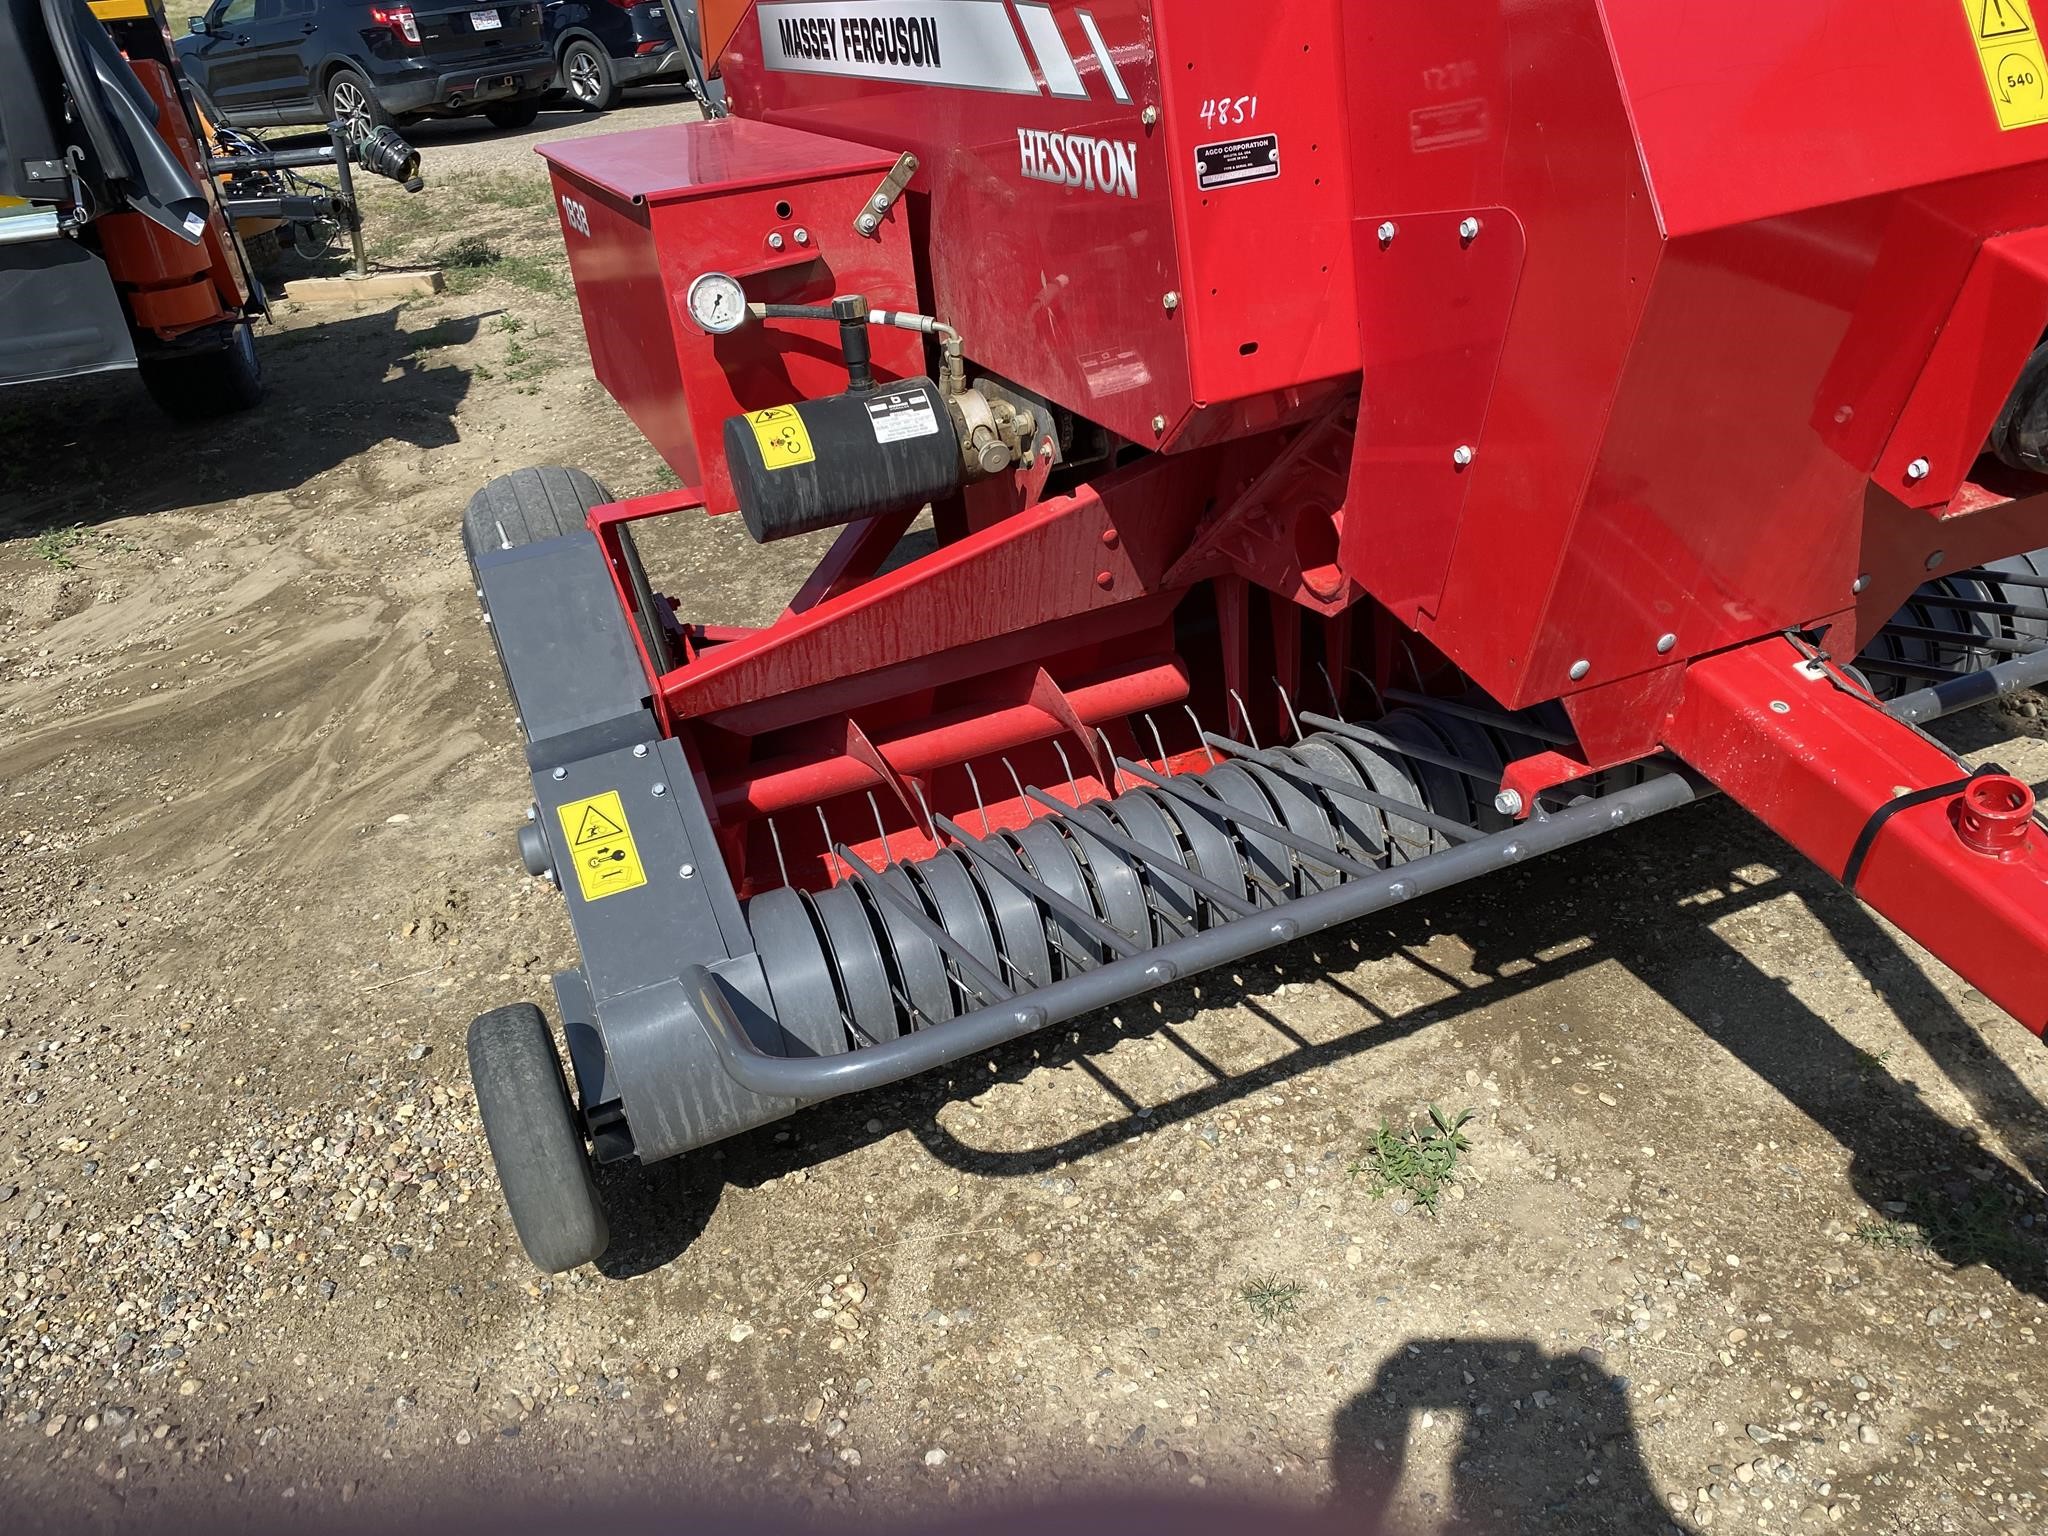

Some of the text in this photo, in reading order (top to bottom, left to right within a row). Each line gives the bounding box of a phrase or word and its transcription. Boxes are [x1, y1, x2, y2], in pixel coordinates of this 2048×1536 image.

[778, 17, 941, 68] MASSEY FERGUSON
[2007, 72, 2034, 88] 540
[1199, 95, 1257, 130] 4851
[1017, 127, 1138, 199] HESSTON
[1205, 139, 1269, 156] AGCO CORPORATION
[561, 195, 591, 238] 1838
